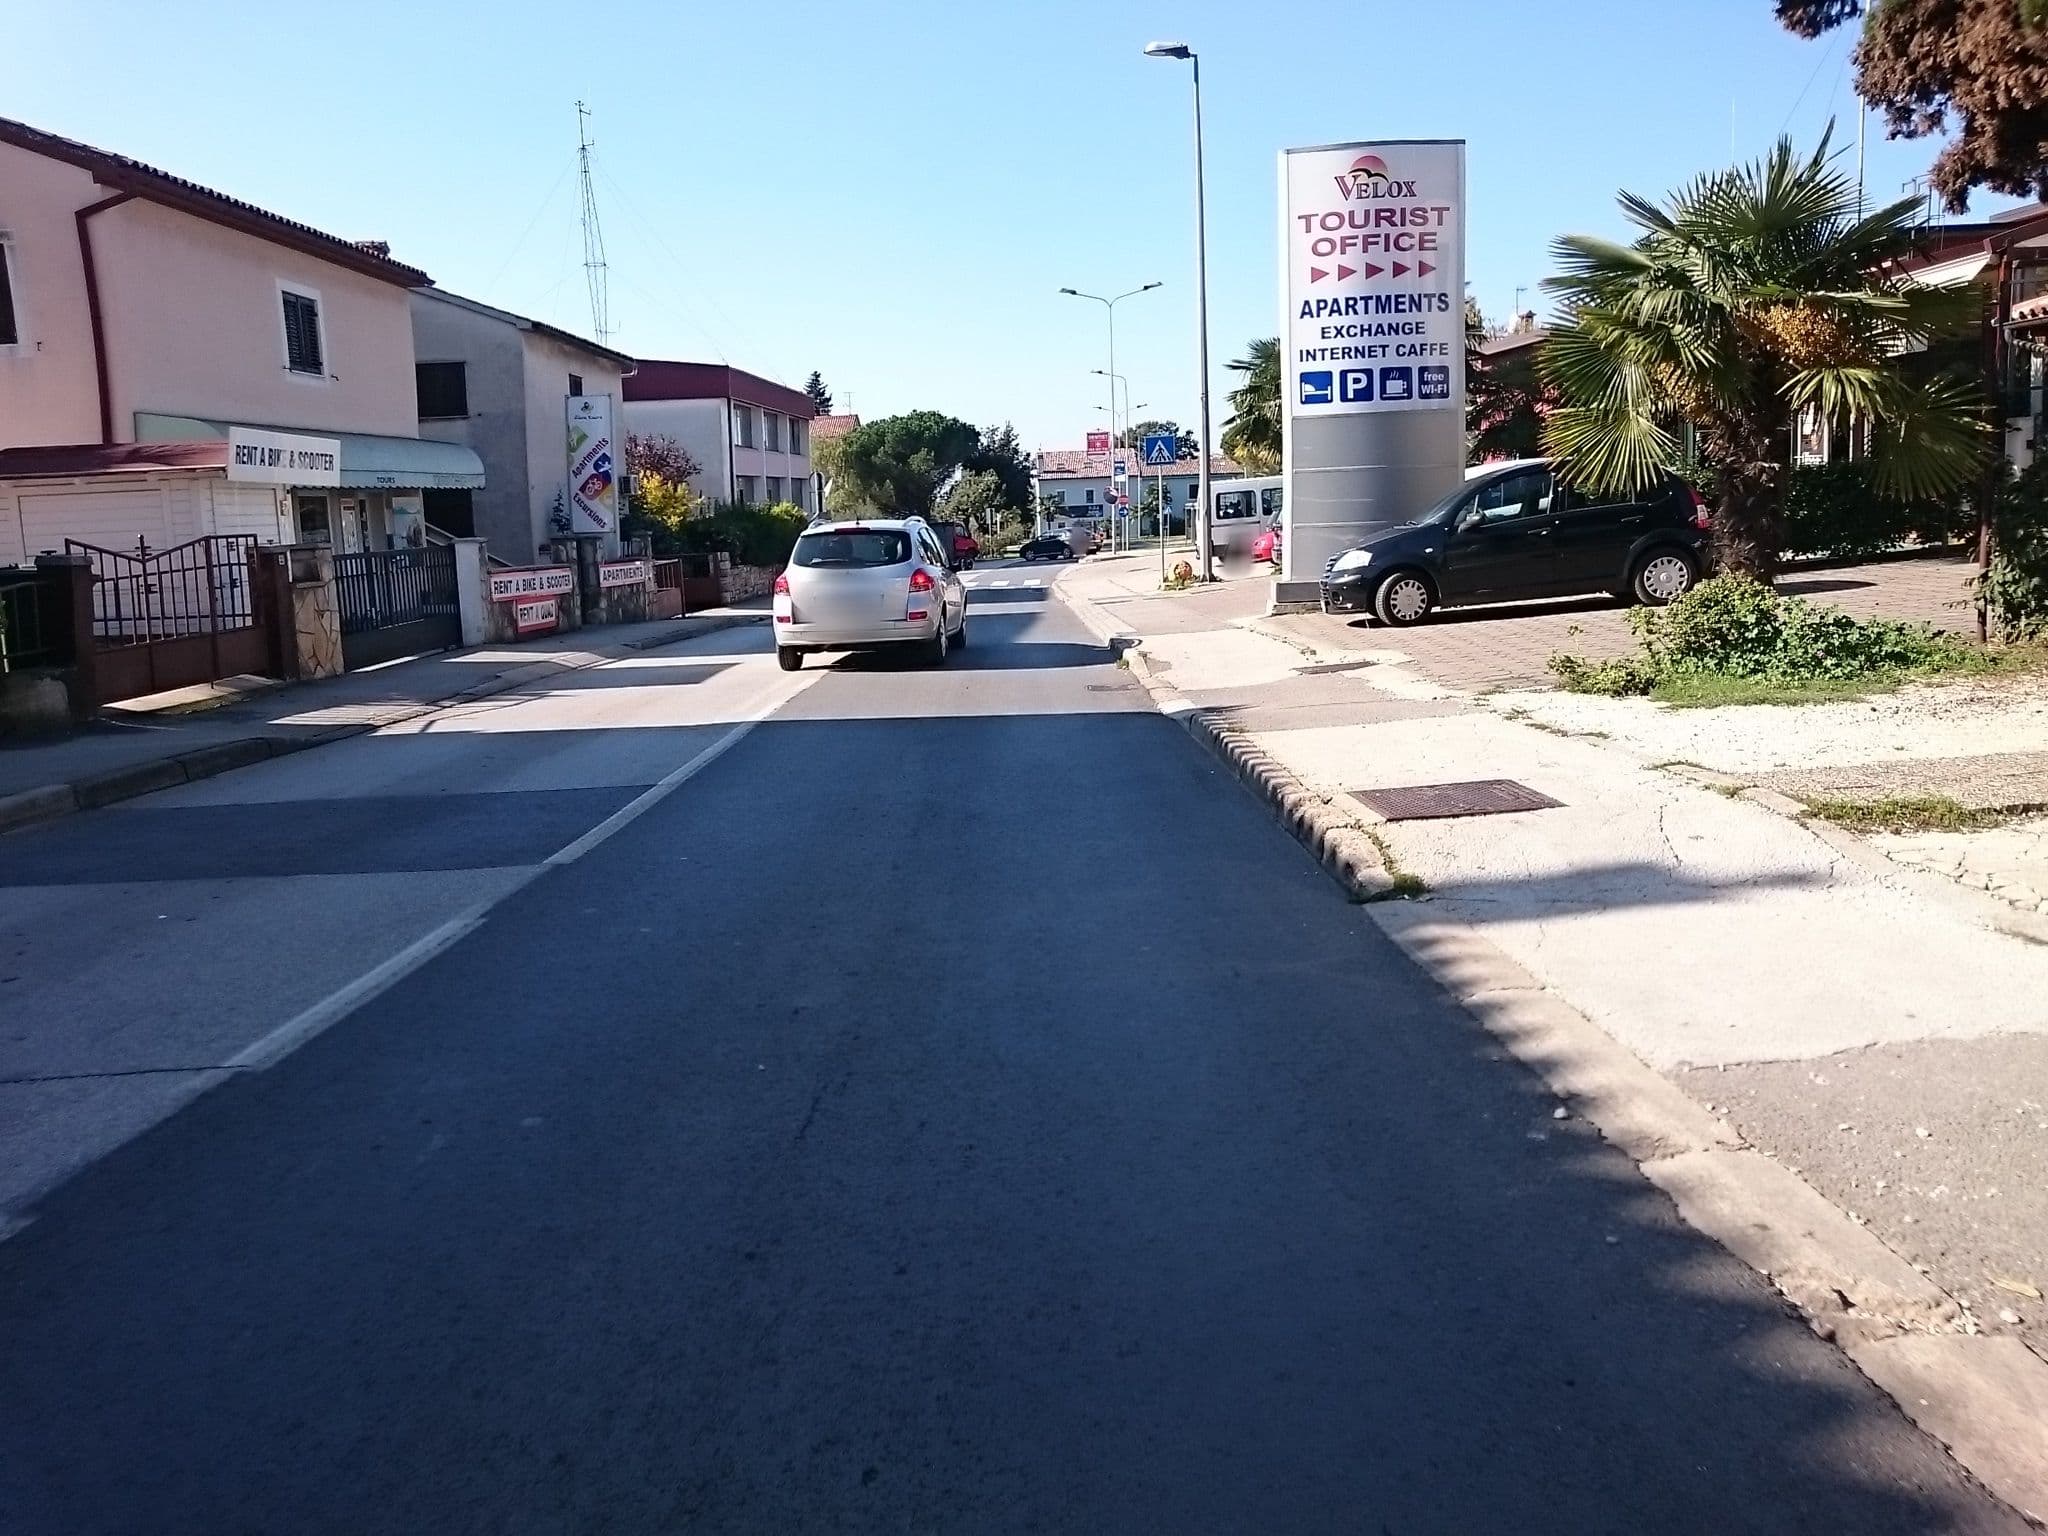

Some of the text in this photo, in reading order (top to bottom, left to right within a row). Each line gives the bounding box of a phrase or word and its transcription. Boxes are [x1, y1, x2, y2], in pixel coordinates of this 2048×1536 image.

[1297, 206, 1450, 233] TOURIST
[1311, 231, 1438, 257] OFFICE
[1299, 292, 1449, 319] APARTMENTS
[1321, 321, 1425, 340] EXCHANGE
[1299, 342, 1449, 362] INTERNET CAFFE
[1346, 372, 1368, 399] P
[1423, 371, 1445, 381] free
[1421, 383, 1447, 395] WI-FI
[235, 444, 258, 466] RENT
[259, 447, 266, 467] A
[289, 450, 296, 469] &
[298, 450, 334, 472] SCOOTER
[571, 437, 609, 479] Apartments
[376, 476, 396, 484] TOURS
[573, 492, 608, 529] Excursions
[493, 574, 571, 595] RENT A BIKE & SCOOTER
[602, 566, 645, 582] APARTMENTS
[519, 606, 534, 621] RENT
